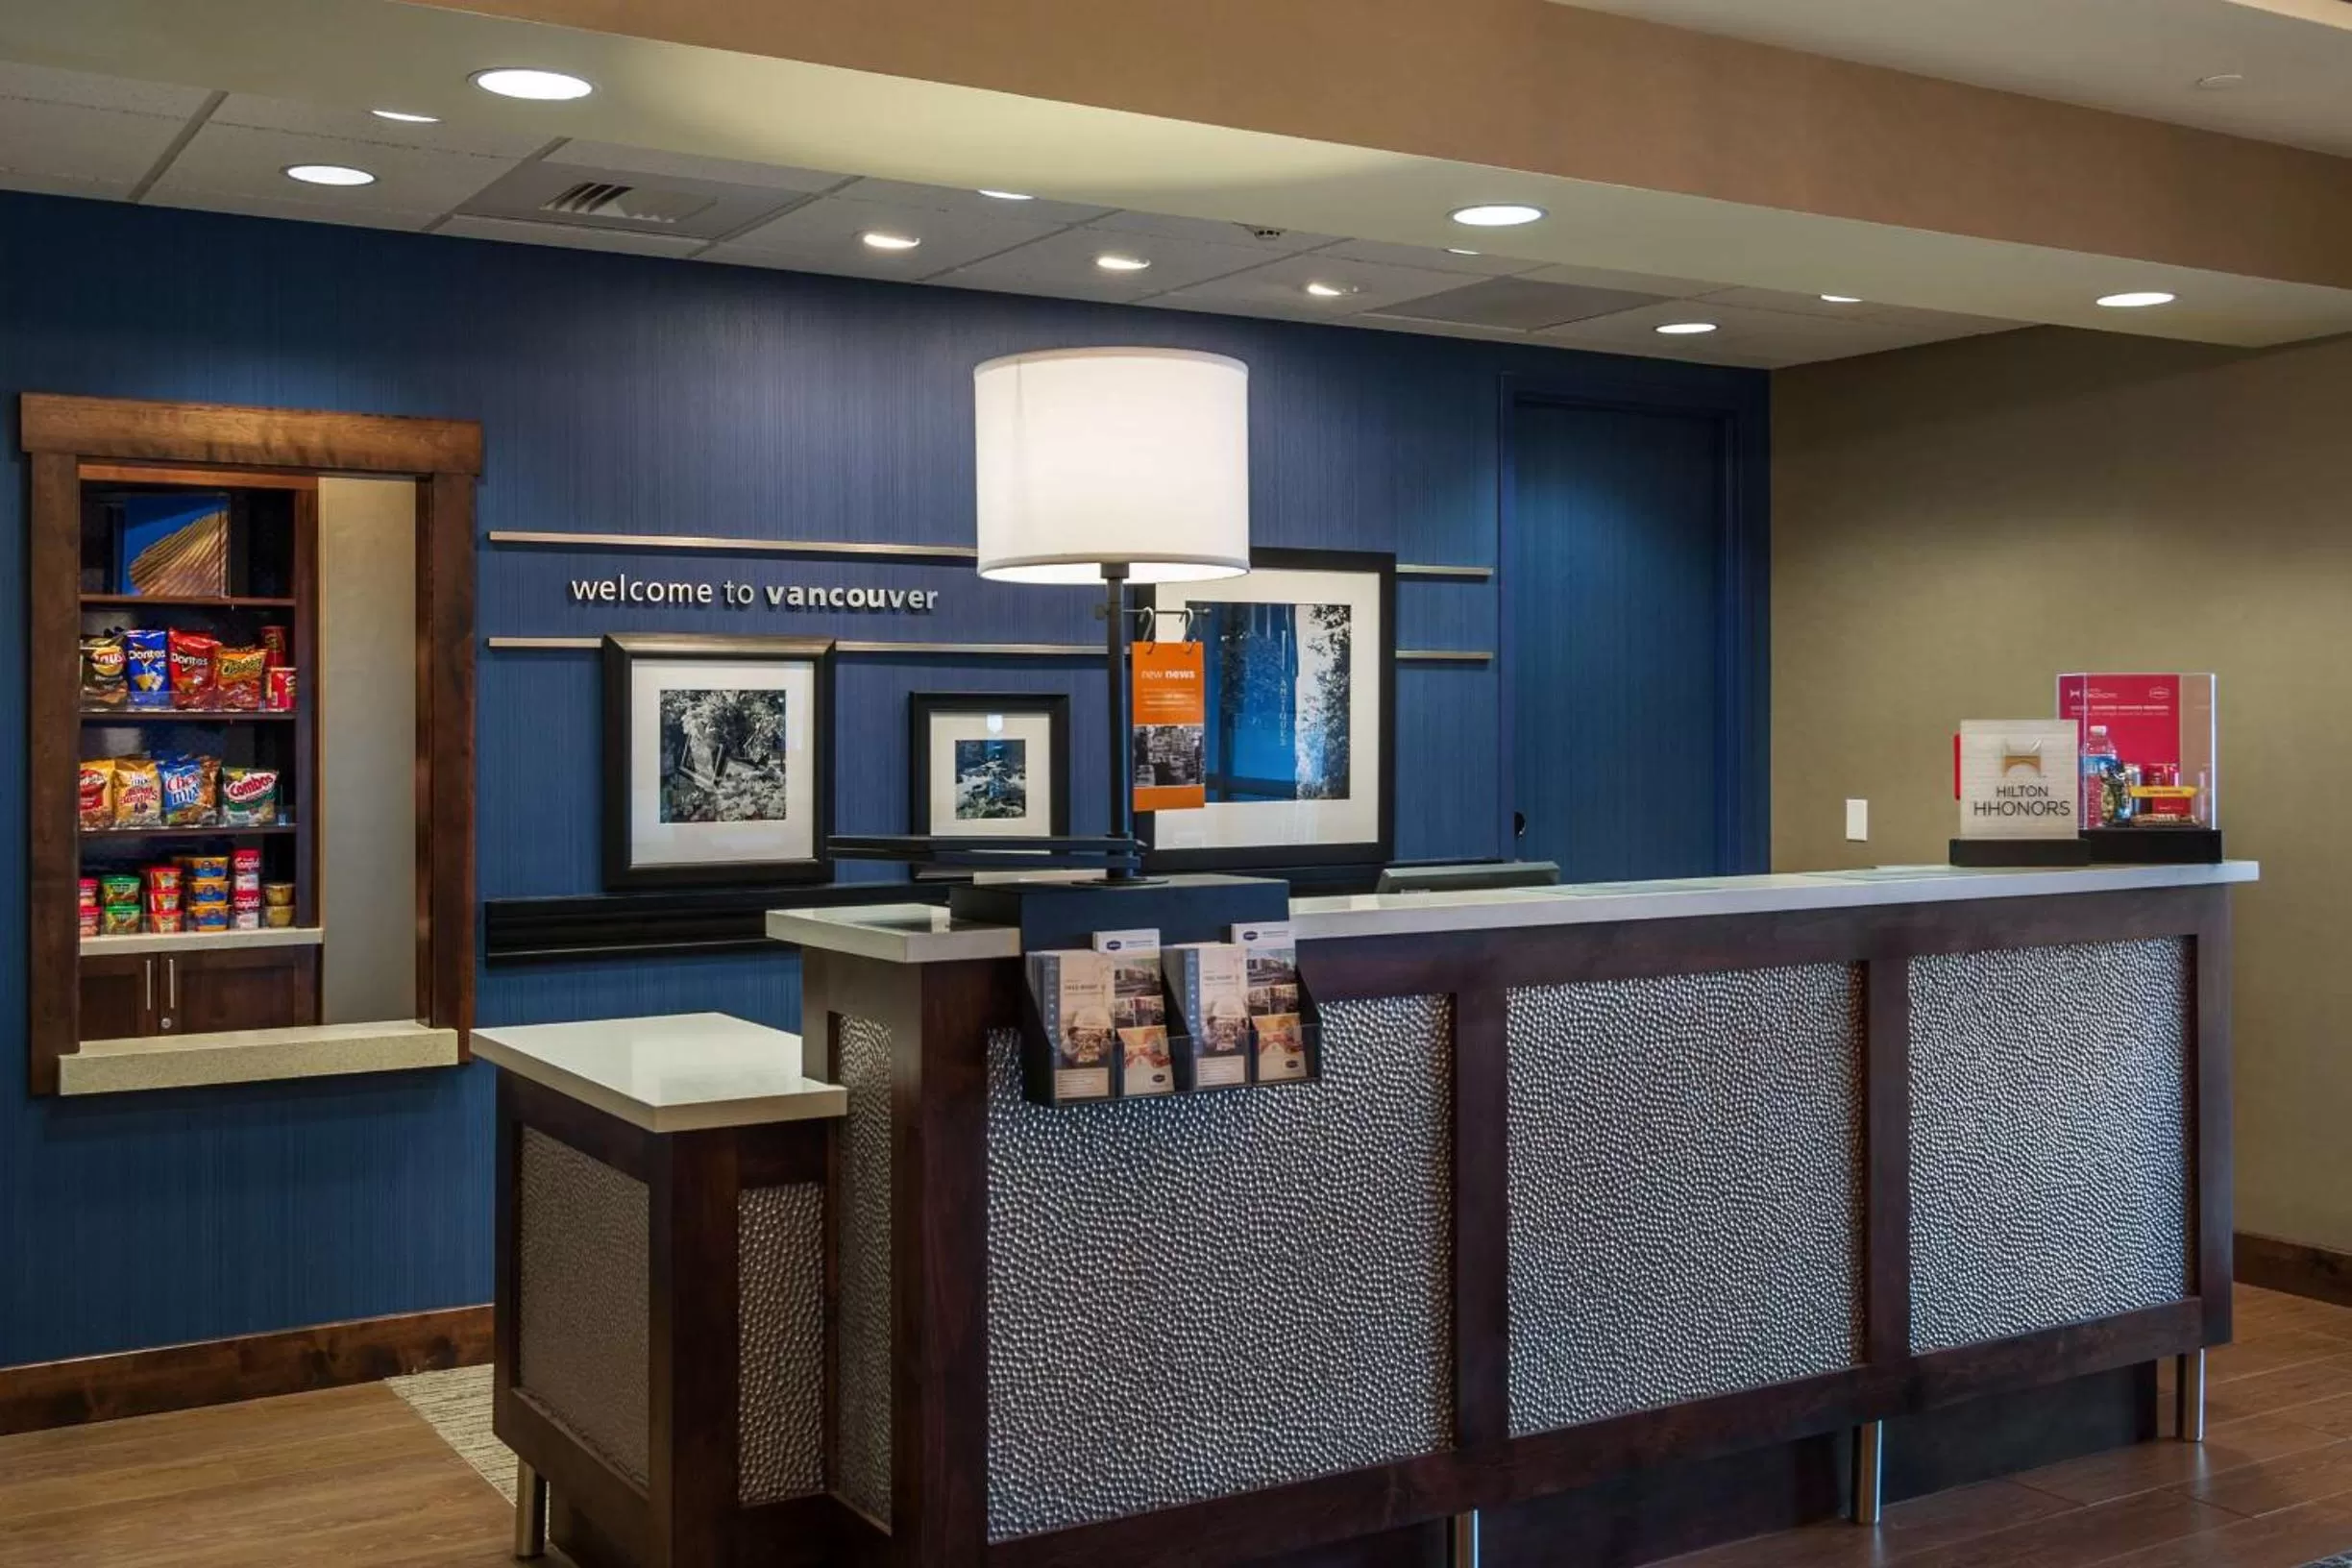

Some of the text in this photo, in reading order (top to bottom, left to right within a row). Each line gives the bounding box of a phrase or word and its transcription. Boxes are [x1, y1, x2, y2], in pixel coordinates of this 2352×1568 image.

[571, 574, 939, 610] welcome to vancouver
[128, 649, 166, 660] Doritos
[170, 652, 208, 666] Doritos
[1141, 670, 1195, 679] new news
[230, 774, 274, 797] Combos
[1996, 785, 2048, 797] HILTON
[1973, 800, 2070, 816] HHONORS
